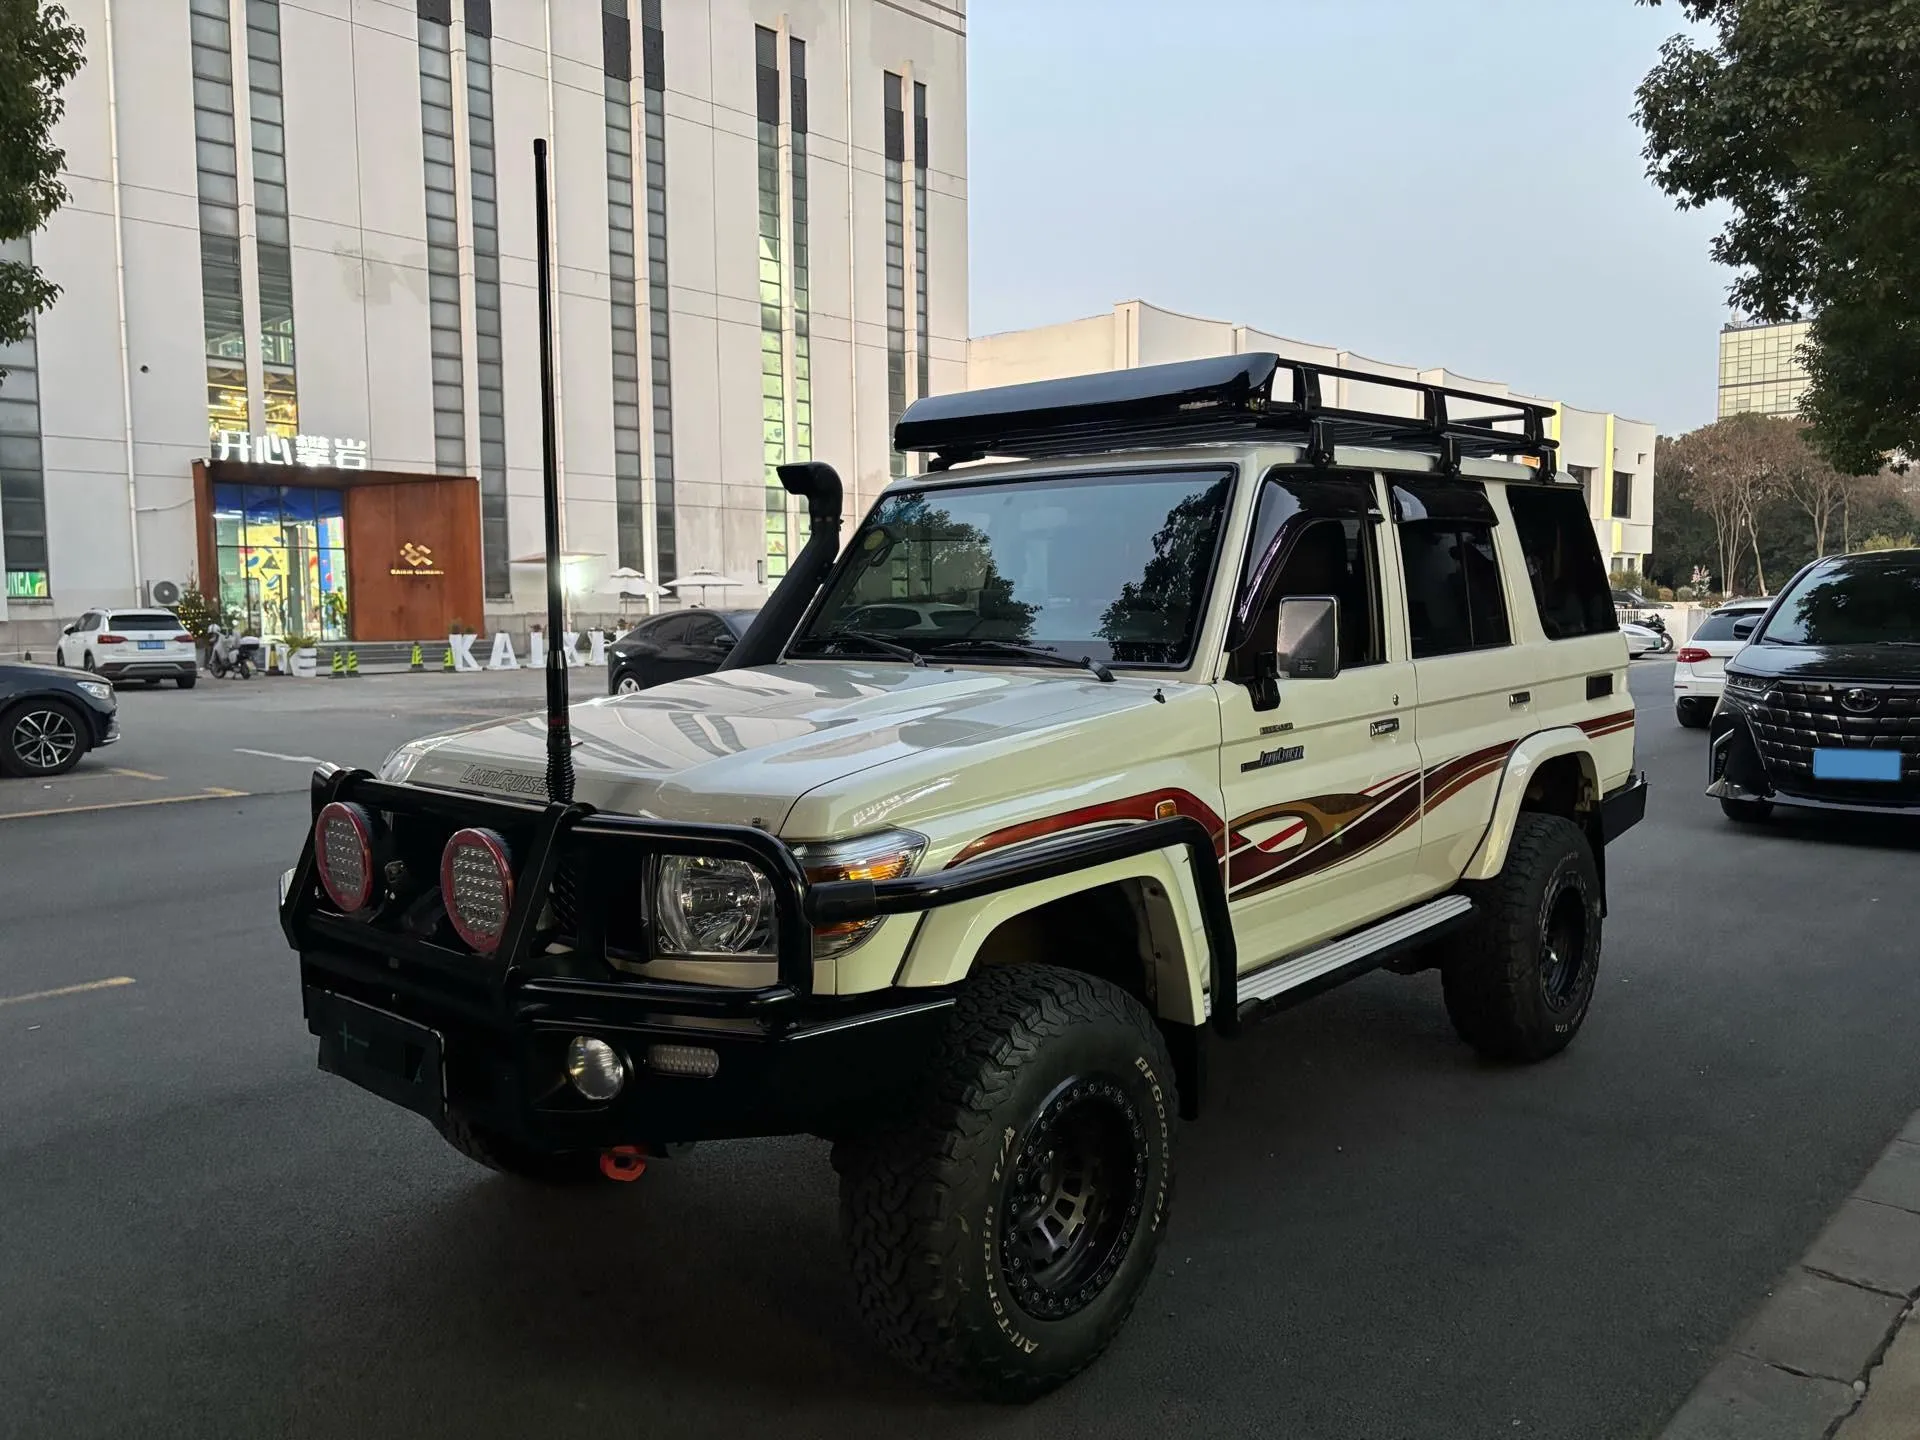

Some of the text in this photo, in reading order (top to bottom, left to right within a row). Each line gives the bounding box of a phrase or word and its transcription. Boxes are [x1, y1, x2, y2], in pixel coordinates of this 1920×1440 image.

[217, 430, 367, 470] 开心攀岩
[449, 629, 628, 672] KAIXI
